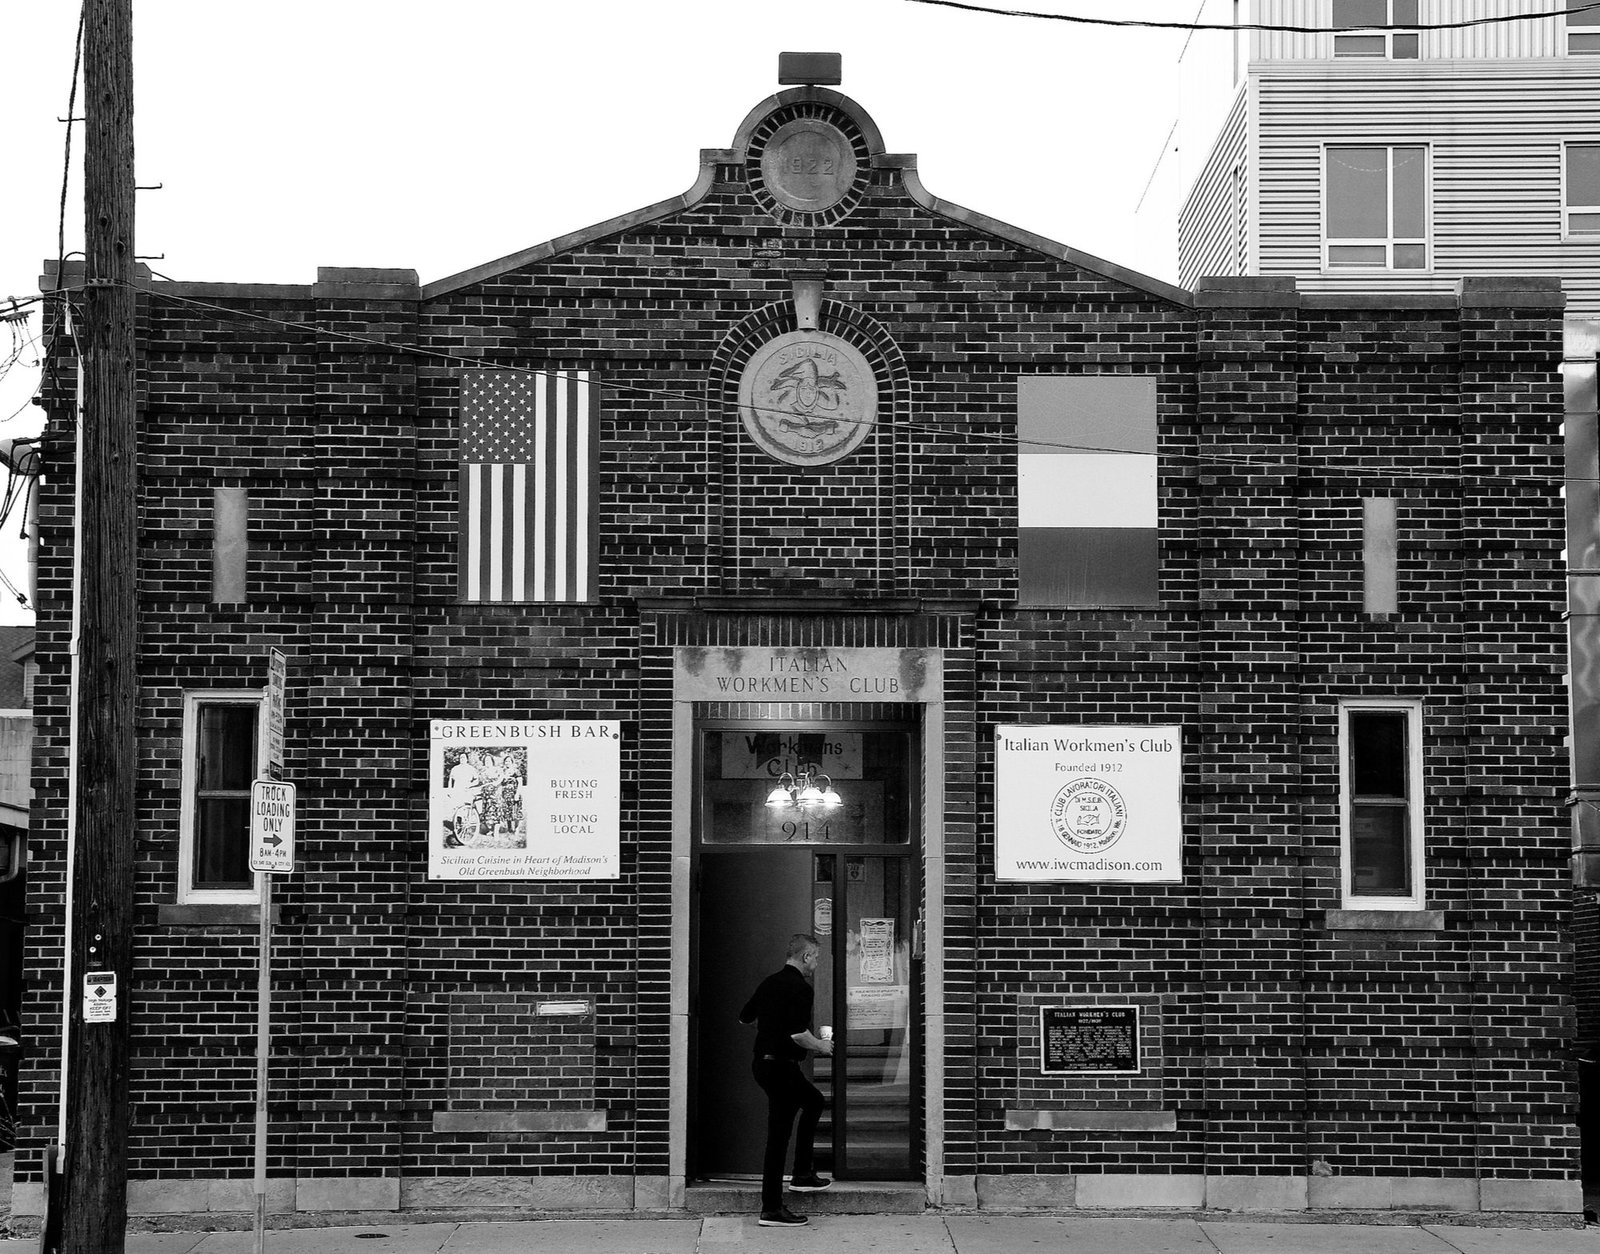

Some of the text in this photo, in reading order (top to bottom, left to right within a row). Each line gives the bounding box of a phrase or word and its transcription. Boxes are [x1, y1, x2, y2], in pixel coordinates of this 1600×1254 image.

[770, 657, 848, 672] ITALIAN
[717, 676, 899, 693] WORKMEN'S CLUB
[442, 725, 610, 738] GREENBUSH BAR
[1005, 738, 1172, 752] Italian Workmen's Club
[767, 758, 817, 777] Club
[1055, 763, 1123, 772] Founded 1912
[550, 779, 598, 788] BUYING
[555, 790, 593, 799] FRESH
[1054, 781, 1123, 817] CLUB LAVORATORI ITALIANI
[257, 801, 290, 818] LOADING
[263, 817, 283, 832] ONLY
[550, 814, 598, 823] BUYING
[554, 825, 594, 834] LOCAL
[781, 820, 831, 841] 914
[441, 855, 608, 866] Sicilian Cuisine in Heart of Madison's
[1016, 858, 1163, 871] www.iwcmadison.com
[458, 867, 591, 877] Old Greenbush Neighborhood
